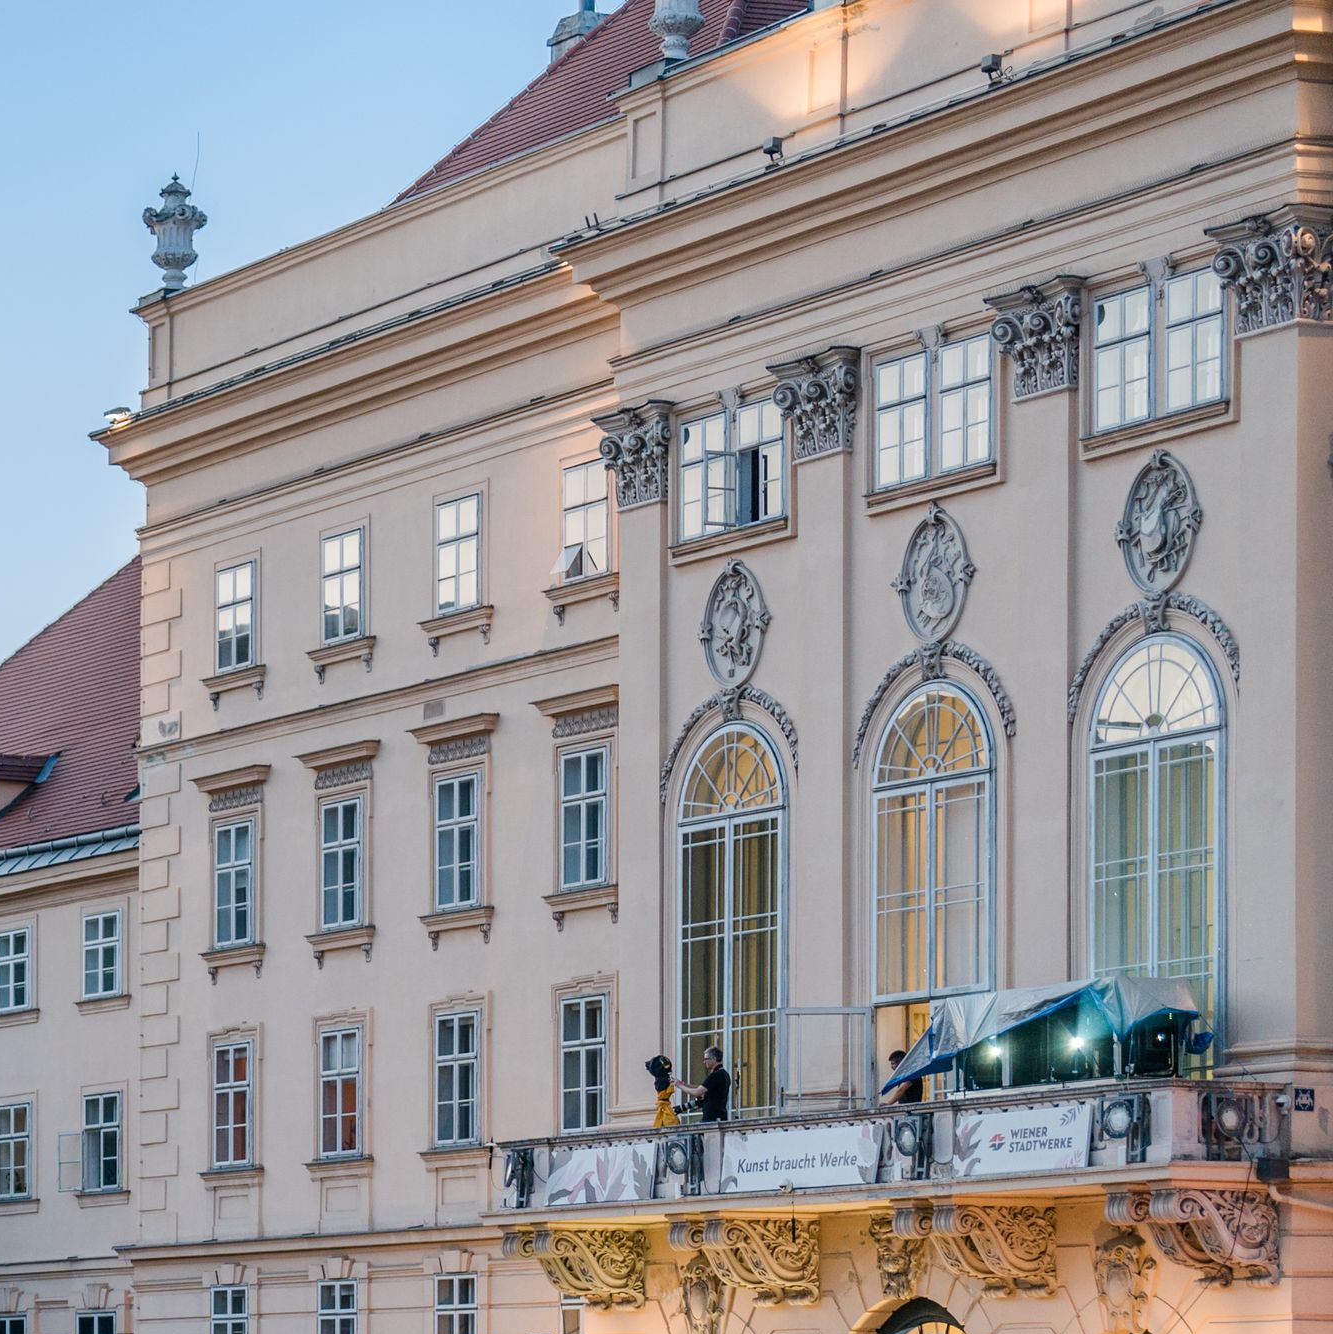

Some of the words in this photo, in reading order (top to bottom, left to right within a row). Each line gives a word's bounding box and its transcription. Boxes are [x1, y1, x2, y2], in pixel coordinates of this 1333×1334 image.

[1010, 1126, 1048, 1139] WIENER
[1008, 1137, 1073, 1153] STADTWERKE
[737, 1158, 770, 1174] Kunst
[772, 1154, 816, 1172] braucht
[819, 1151, 858, 1167] Werke
